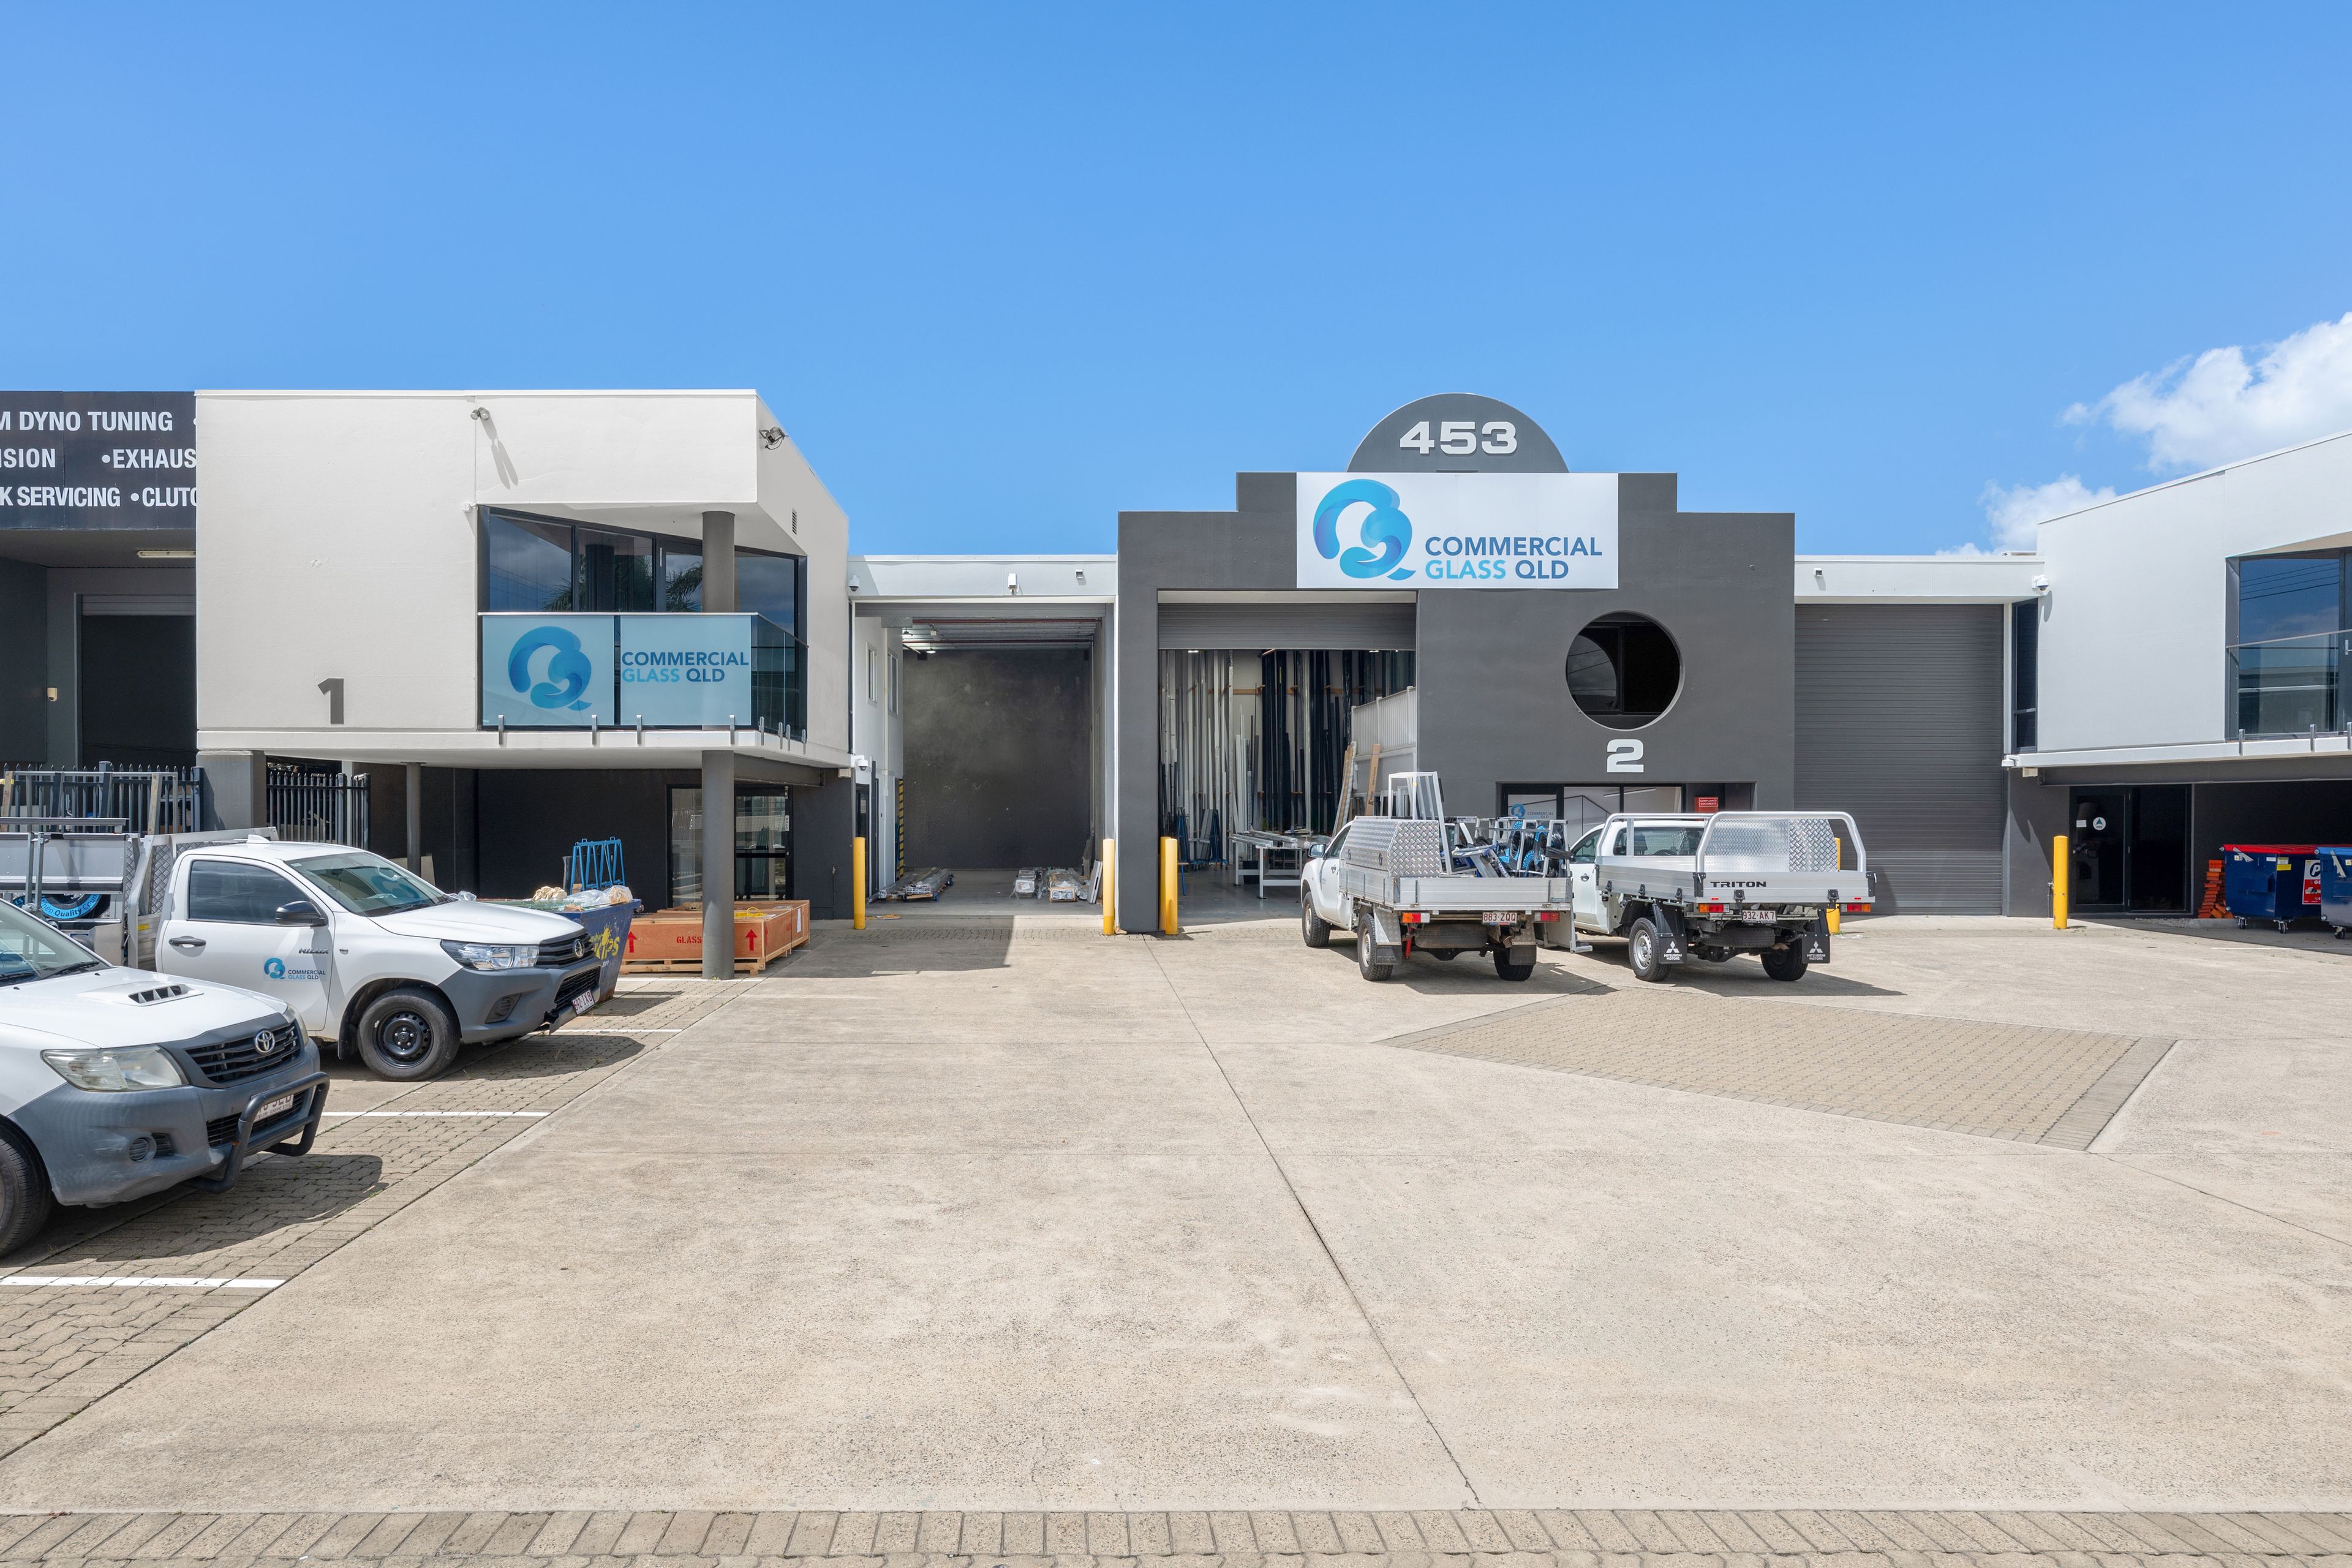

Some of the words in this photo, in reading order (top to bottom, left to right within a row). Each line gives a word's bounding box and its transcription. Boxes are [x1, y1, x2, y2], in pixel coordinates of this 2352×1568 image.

[19, 411, 81, 431] DYNO
[88, 411, 173, 431] TUNING
[1399, 421, 1518, 455] 453
[0, 448, 56, 468] SION
[17, 486, 121, 507] SERVICING
[1425, 536, 1602, 556] COMMERCIAL
[1425, 559, 1507, 579] GLASS
[1515, 559, 1569, 579] QLD
[622, 652, 749, 666] COMMERCIAL
[622, 668, 680, 683] GLASS
[685, 668, 725, 683] QLD
[317, 678, 344, 725] 1
[1606, 739, 1644, 774] 2
[55, 908, 82, 917] Quality
